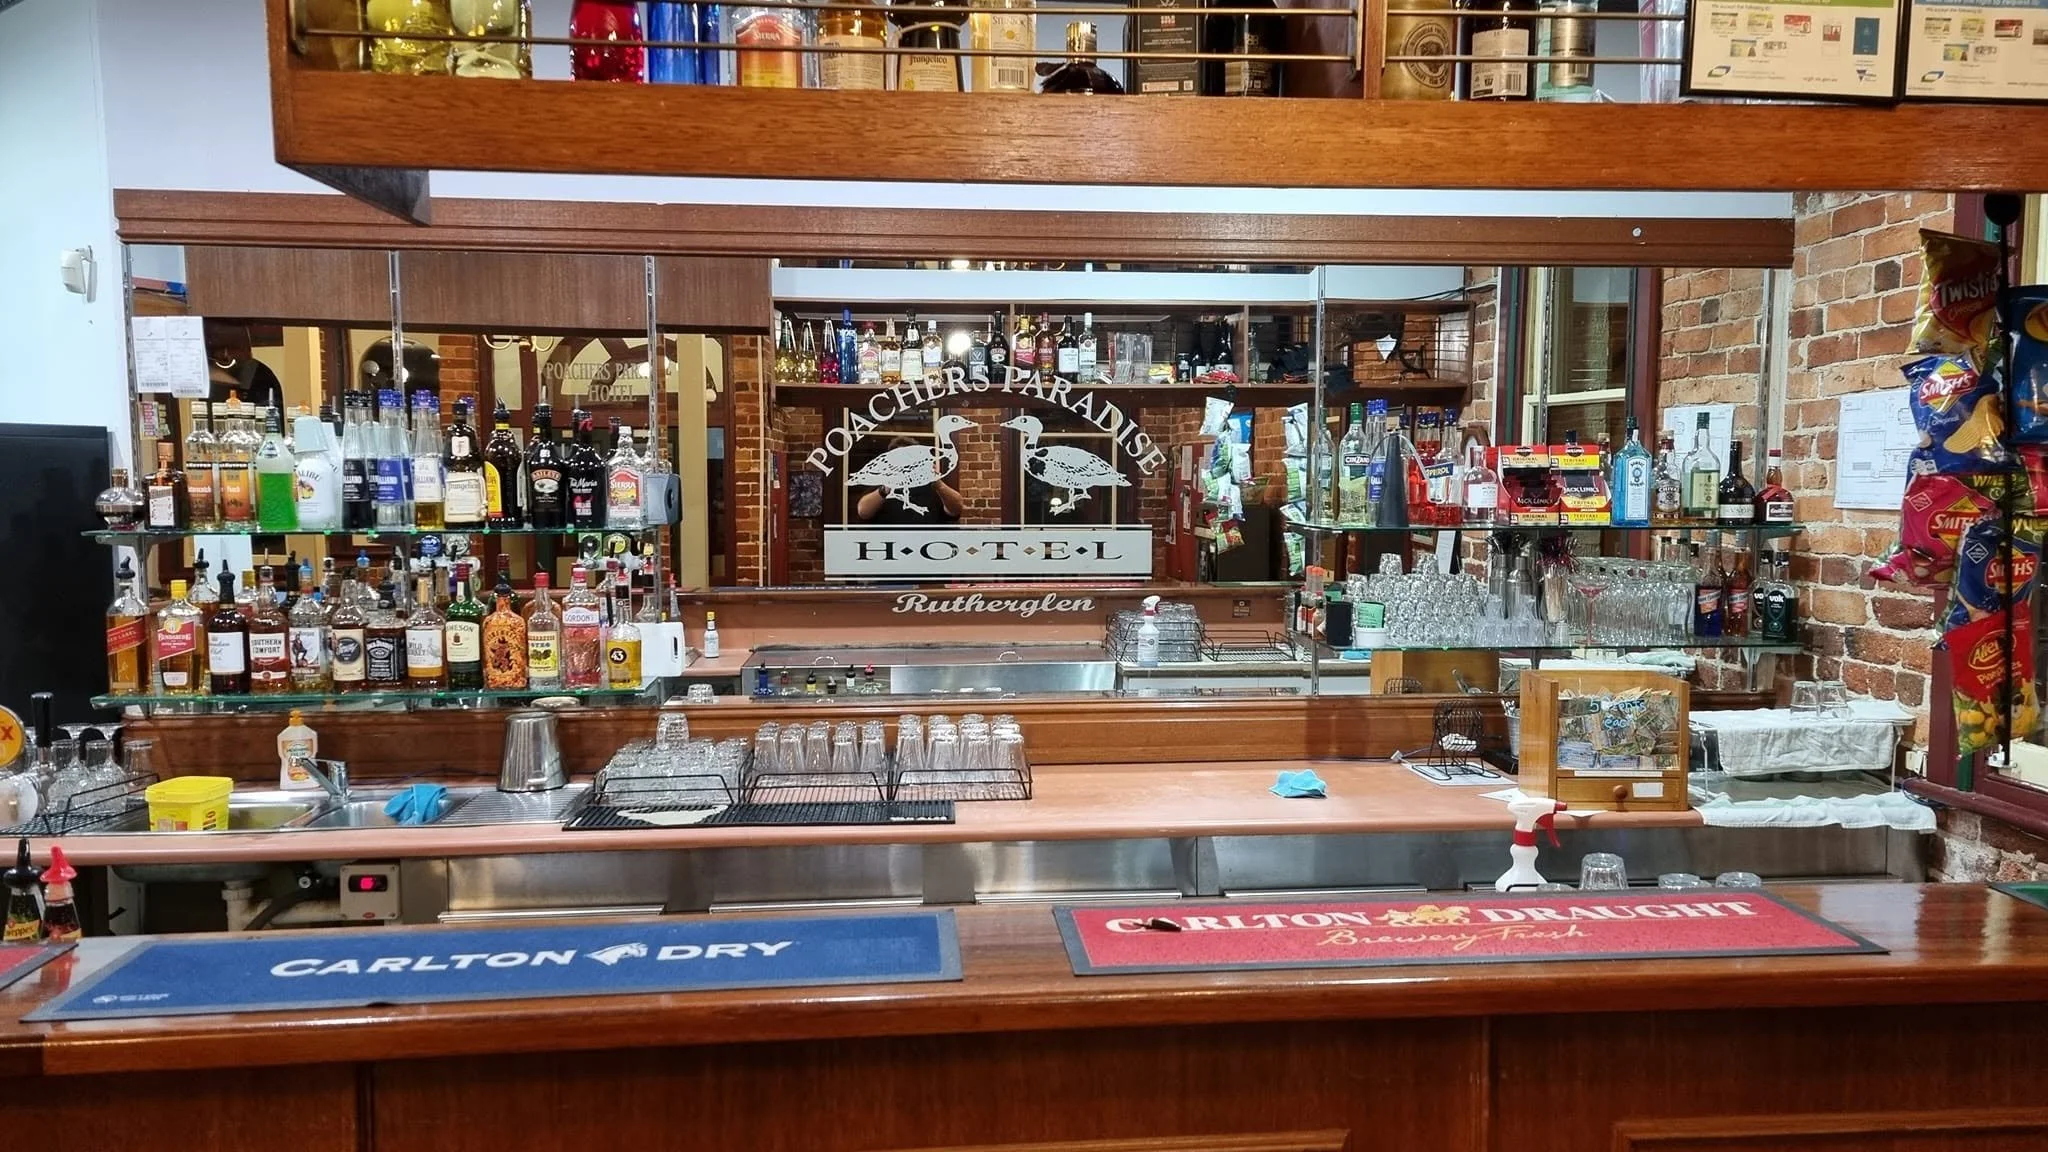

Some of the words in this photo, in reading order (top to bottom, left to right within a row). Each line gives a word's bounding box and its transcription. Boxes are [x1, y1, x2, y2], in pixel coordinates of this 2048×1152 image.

[588, 384, 637, 402] HOTEL
[805, 365, 990, 477] POACHERS
[1000, 365, 1170, 475] PARADISE
[1345, 456, 1370, 464] CINZANO
[610, 479, 636, 489] SIERRA
[892, 593, 1095, 619] Rutherglen
[1769, 595, 1784, 603] vok
[251, 639, 282, 647] SOUTHERN
[1477, 902, 1760, 922] DRAUGHT
[1316, 930, 1480, 951] Brewery
[1481, 923, 1592, 940] Fresh
[269, 948, 578, 978] CARLTON
[656, 940, 795, 962] DRY
